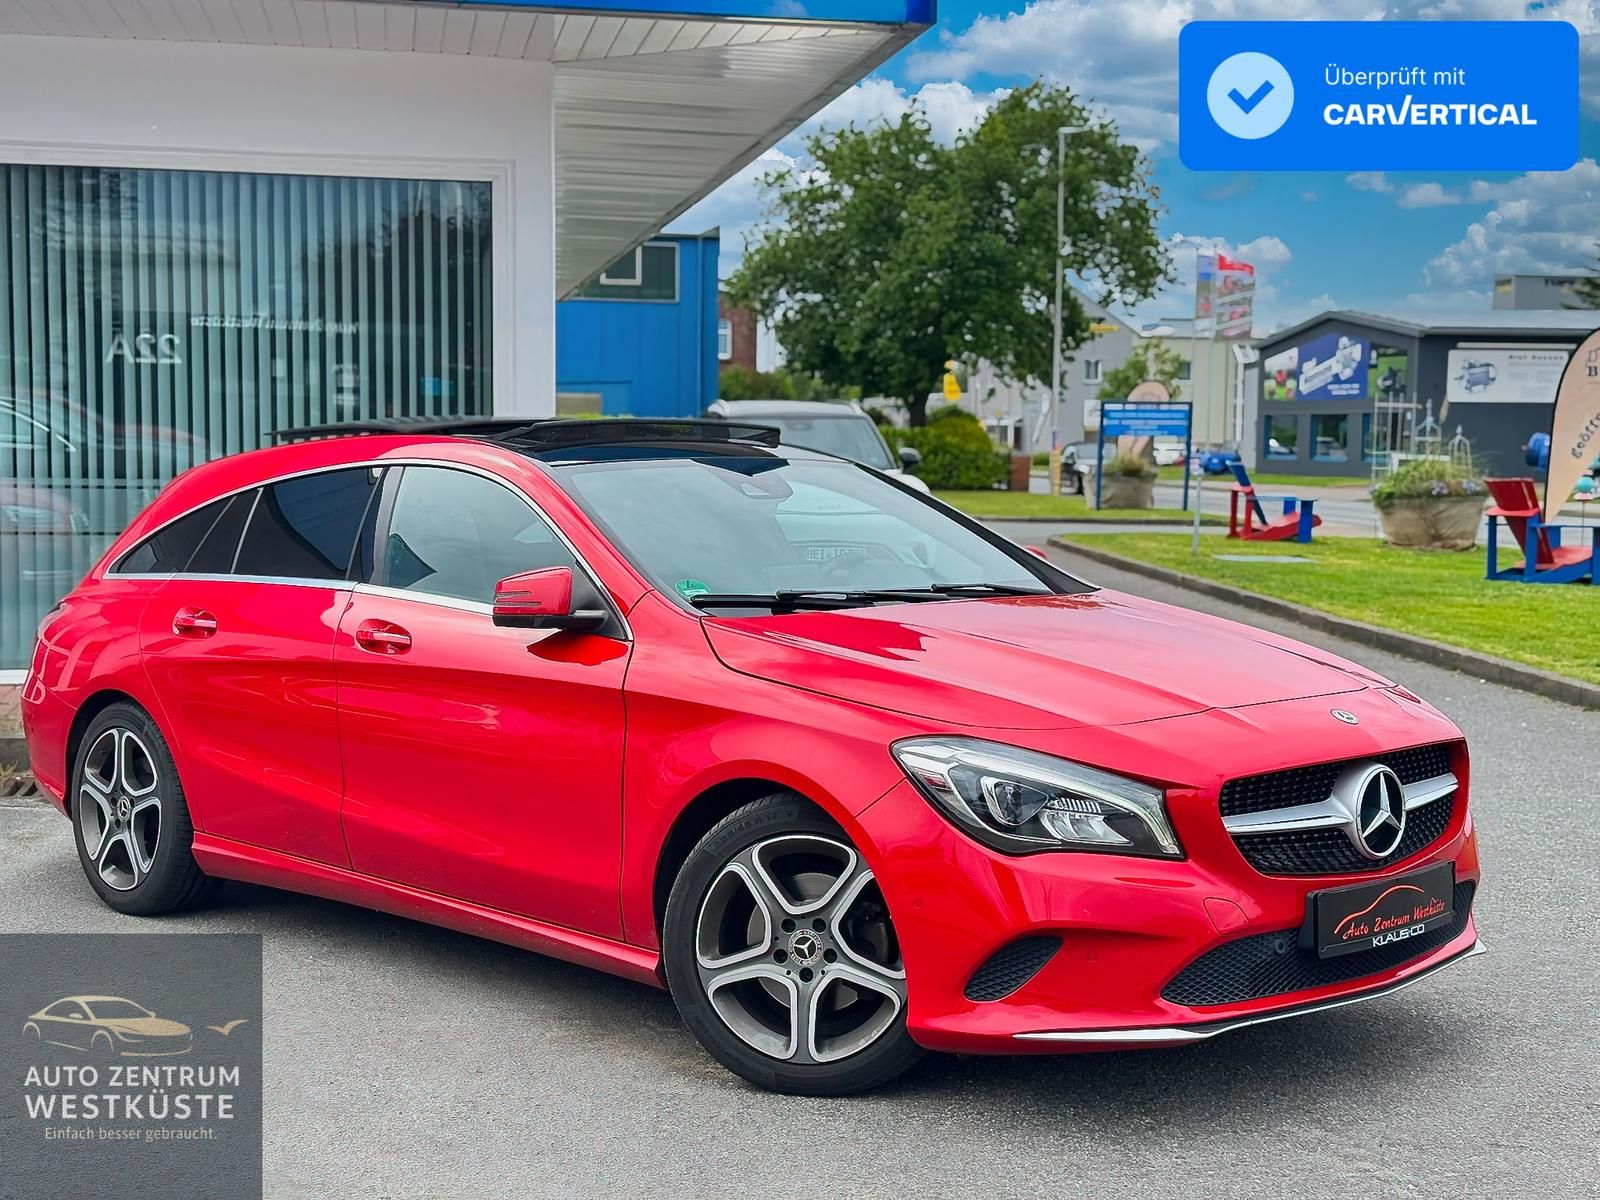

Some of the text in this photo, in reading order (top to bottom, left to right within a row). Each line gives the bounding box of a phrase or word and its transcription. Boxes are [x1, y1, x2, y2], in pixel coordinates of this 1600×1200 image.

[1342, 898, 1446, 940] Auto Zentrum Westküste
